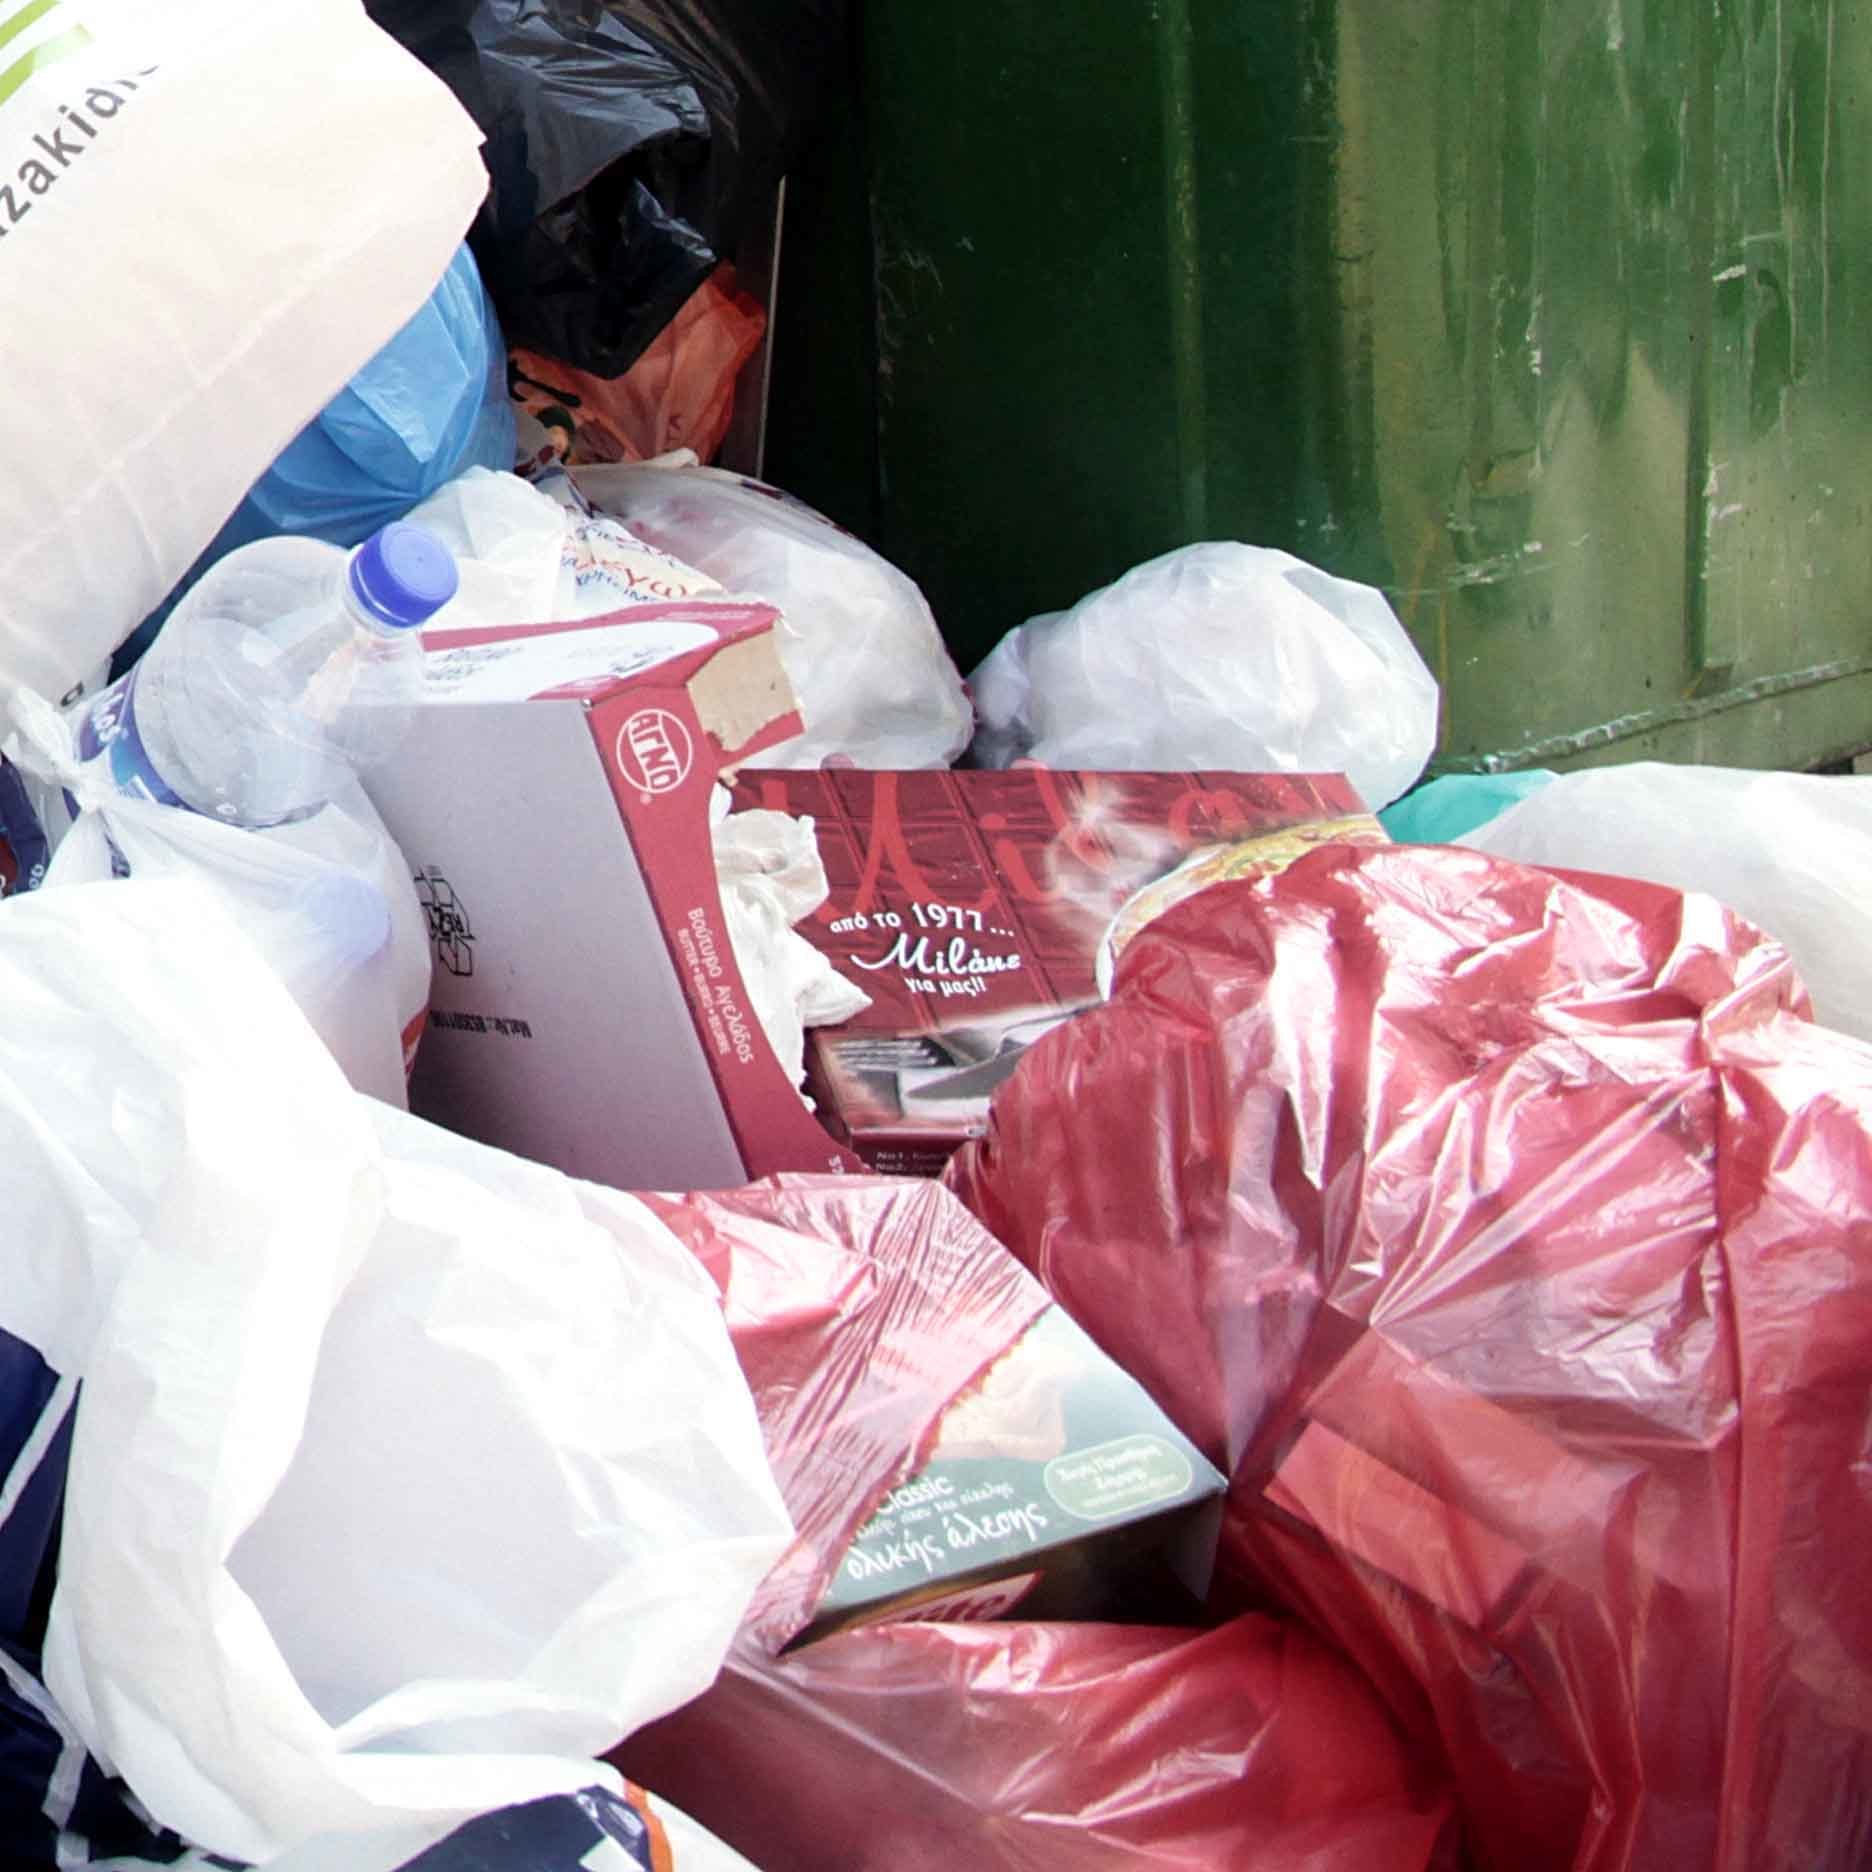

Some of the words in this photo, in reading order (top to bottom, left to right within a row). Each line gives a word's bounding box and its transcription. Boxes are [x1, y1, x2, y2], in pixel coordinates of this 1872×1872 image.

[829, 911, 869, 934] από
[872, 912, 903, 929] το
[903, 976, 937, 994] για
[940, 1502, 1049, 1550] άλεσης
